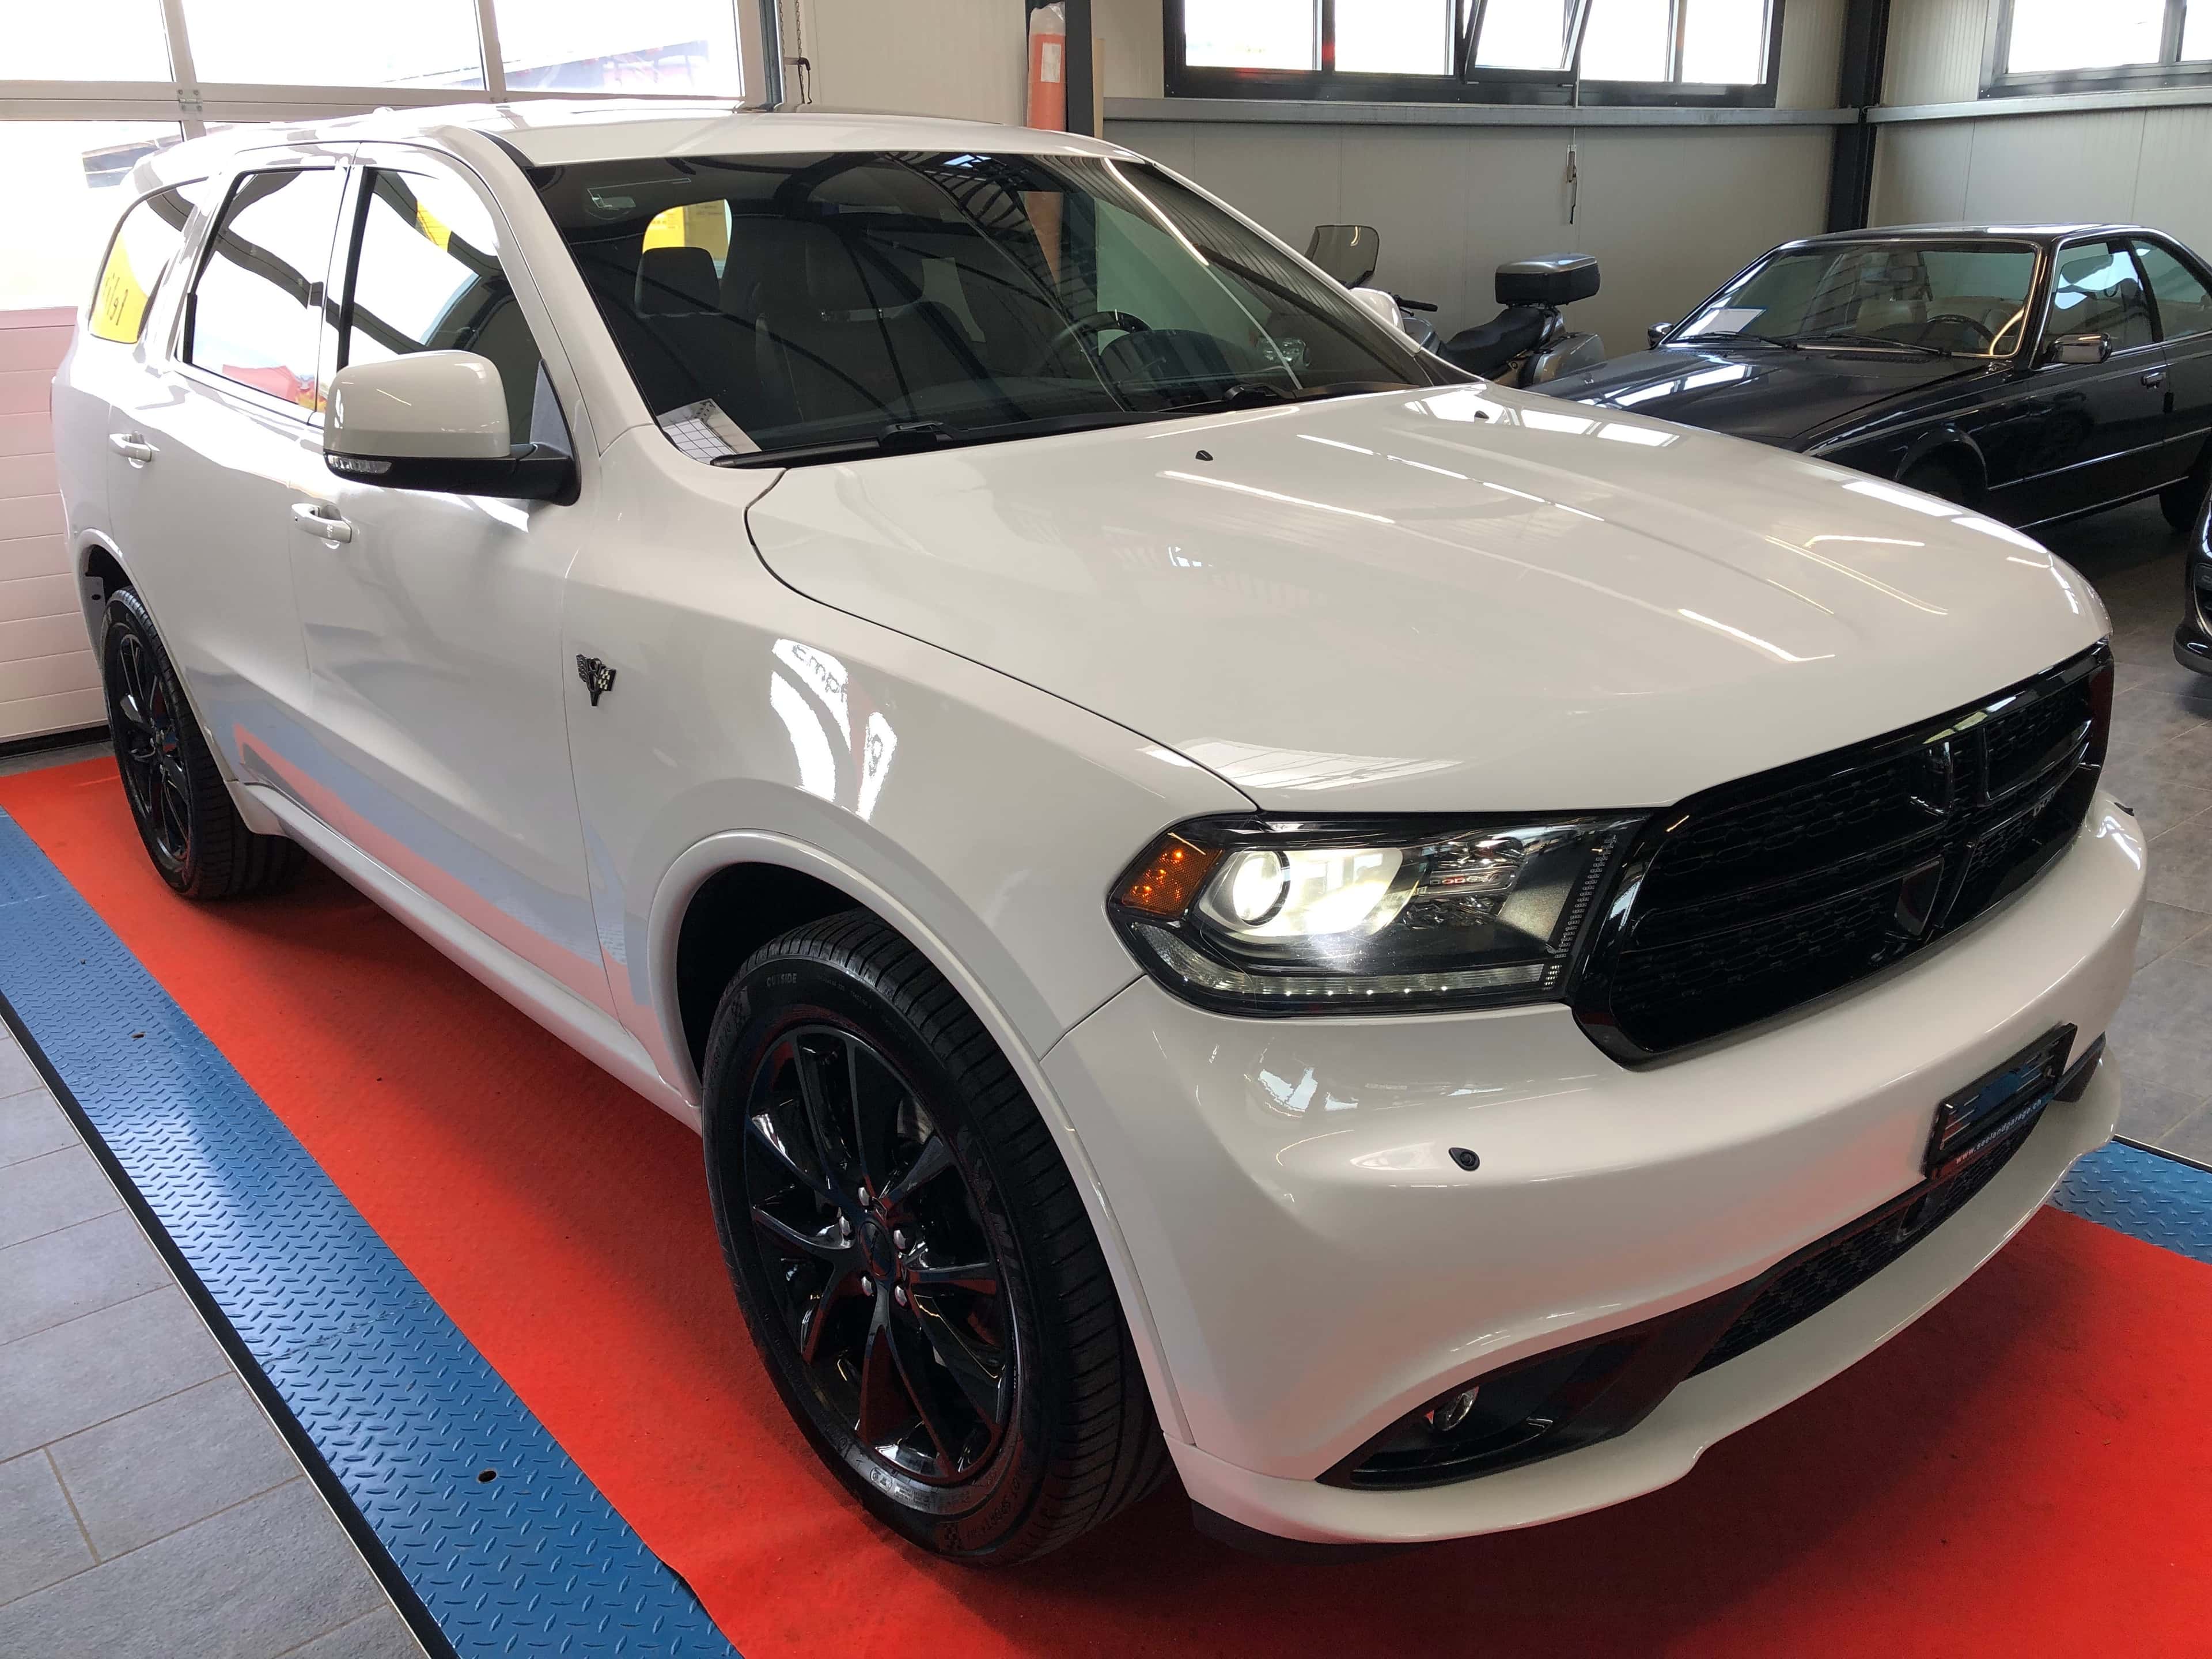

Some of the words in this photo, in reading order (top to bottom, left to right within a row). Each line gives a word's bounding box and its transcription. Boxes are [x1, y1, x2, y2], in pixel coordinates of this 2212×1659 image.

[1430, 876, 1489, 885] DODGE
[766, 972, 797, 987] OUTSIDE
[1956, 1099, 2042, 1164] www.seelandgarage.ch
